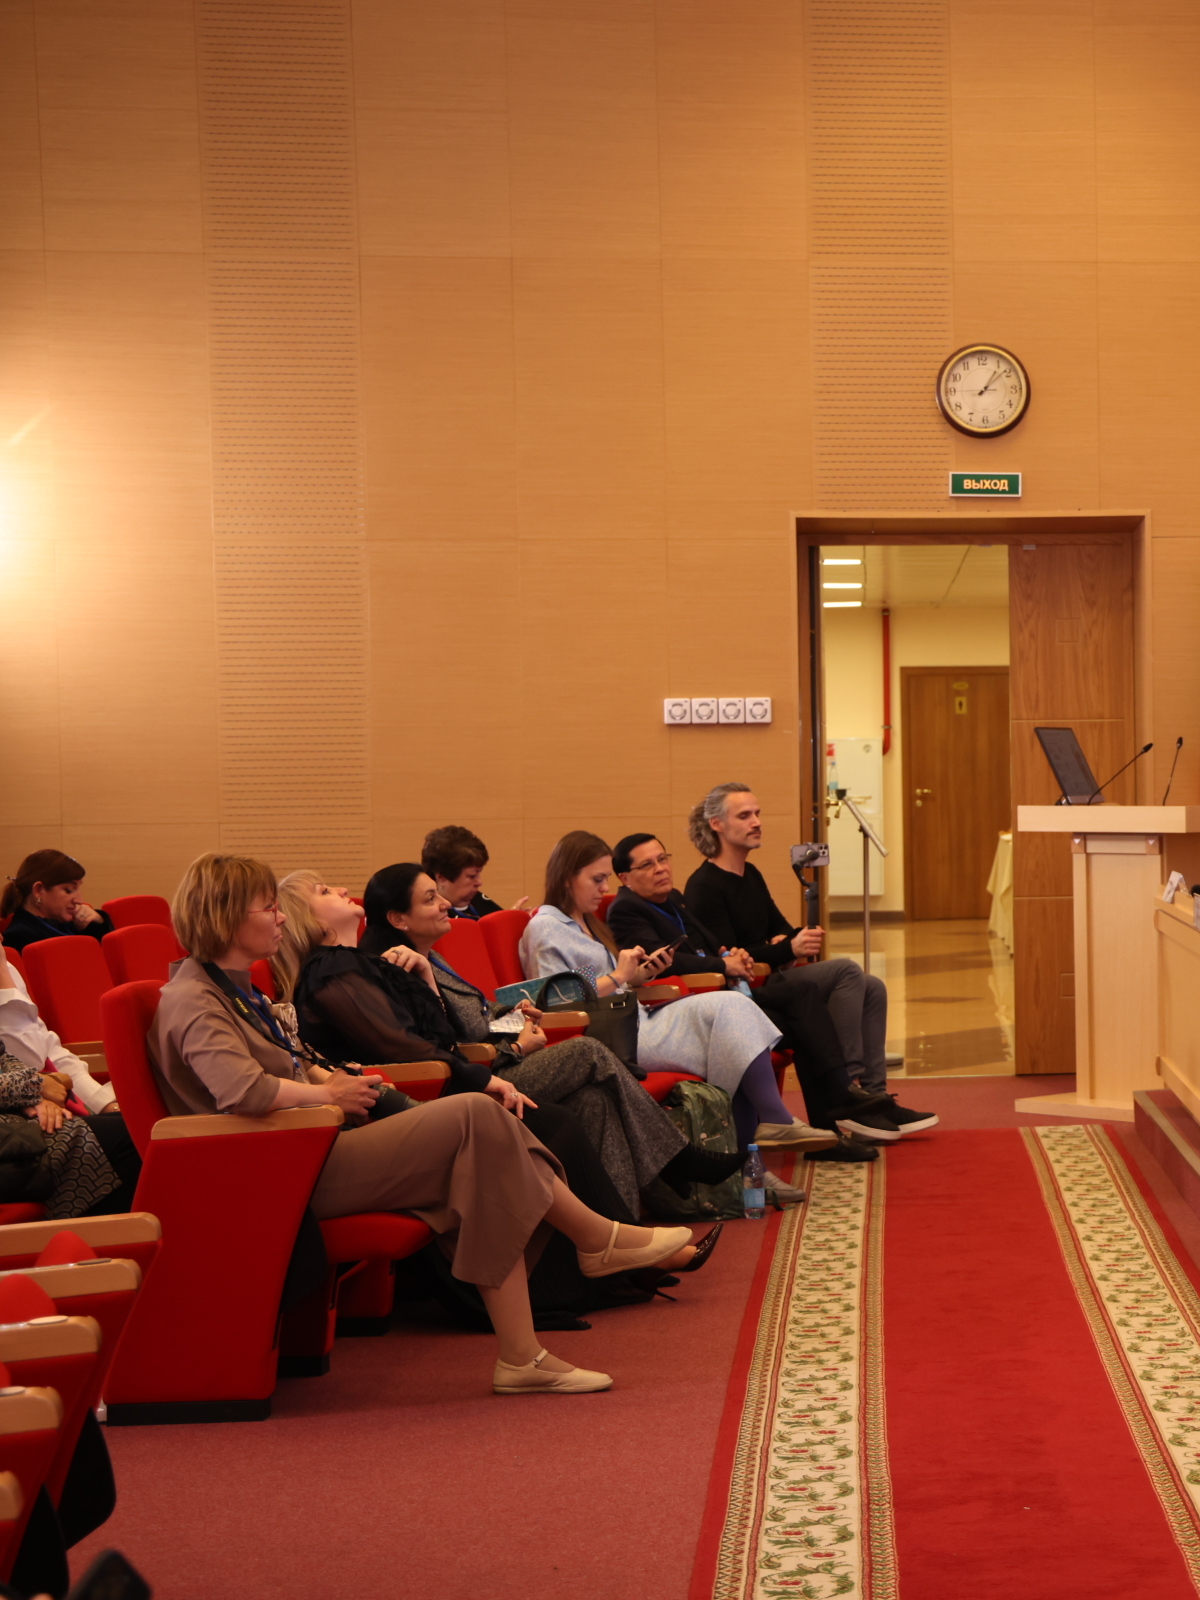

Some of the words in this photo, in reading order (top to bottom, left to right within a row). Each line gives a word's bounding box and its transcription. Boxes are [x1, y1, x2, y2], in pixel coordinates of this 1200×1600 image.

[962, 361, 970, 371] 11
[977, 356, 987, 366] 12
[996, 359, 1000, 369] 1
[952, 373, 961, 383] 10
[1005, 369, 1012, 378] 2
[949, 387, 956, 396] 9
[1010, 385, 1018, 395] 3
[955, 402, 962, 411] 8
[1006, 400, 1014, 409] 4
[968, 412, 974, 422] 7
[982, 415, 989, 425] 6
[998, 410, 1006, 420] 5
[963, 479, 1009, 491] ВЫХОД
